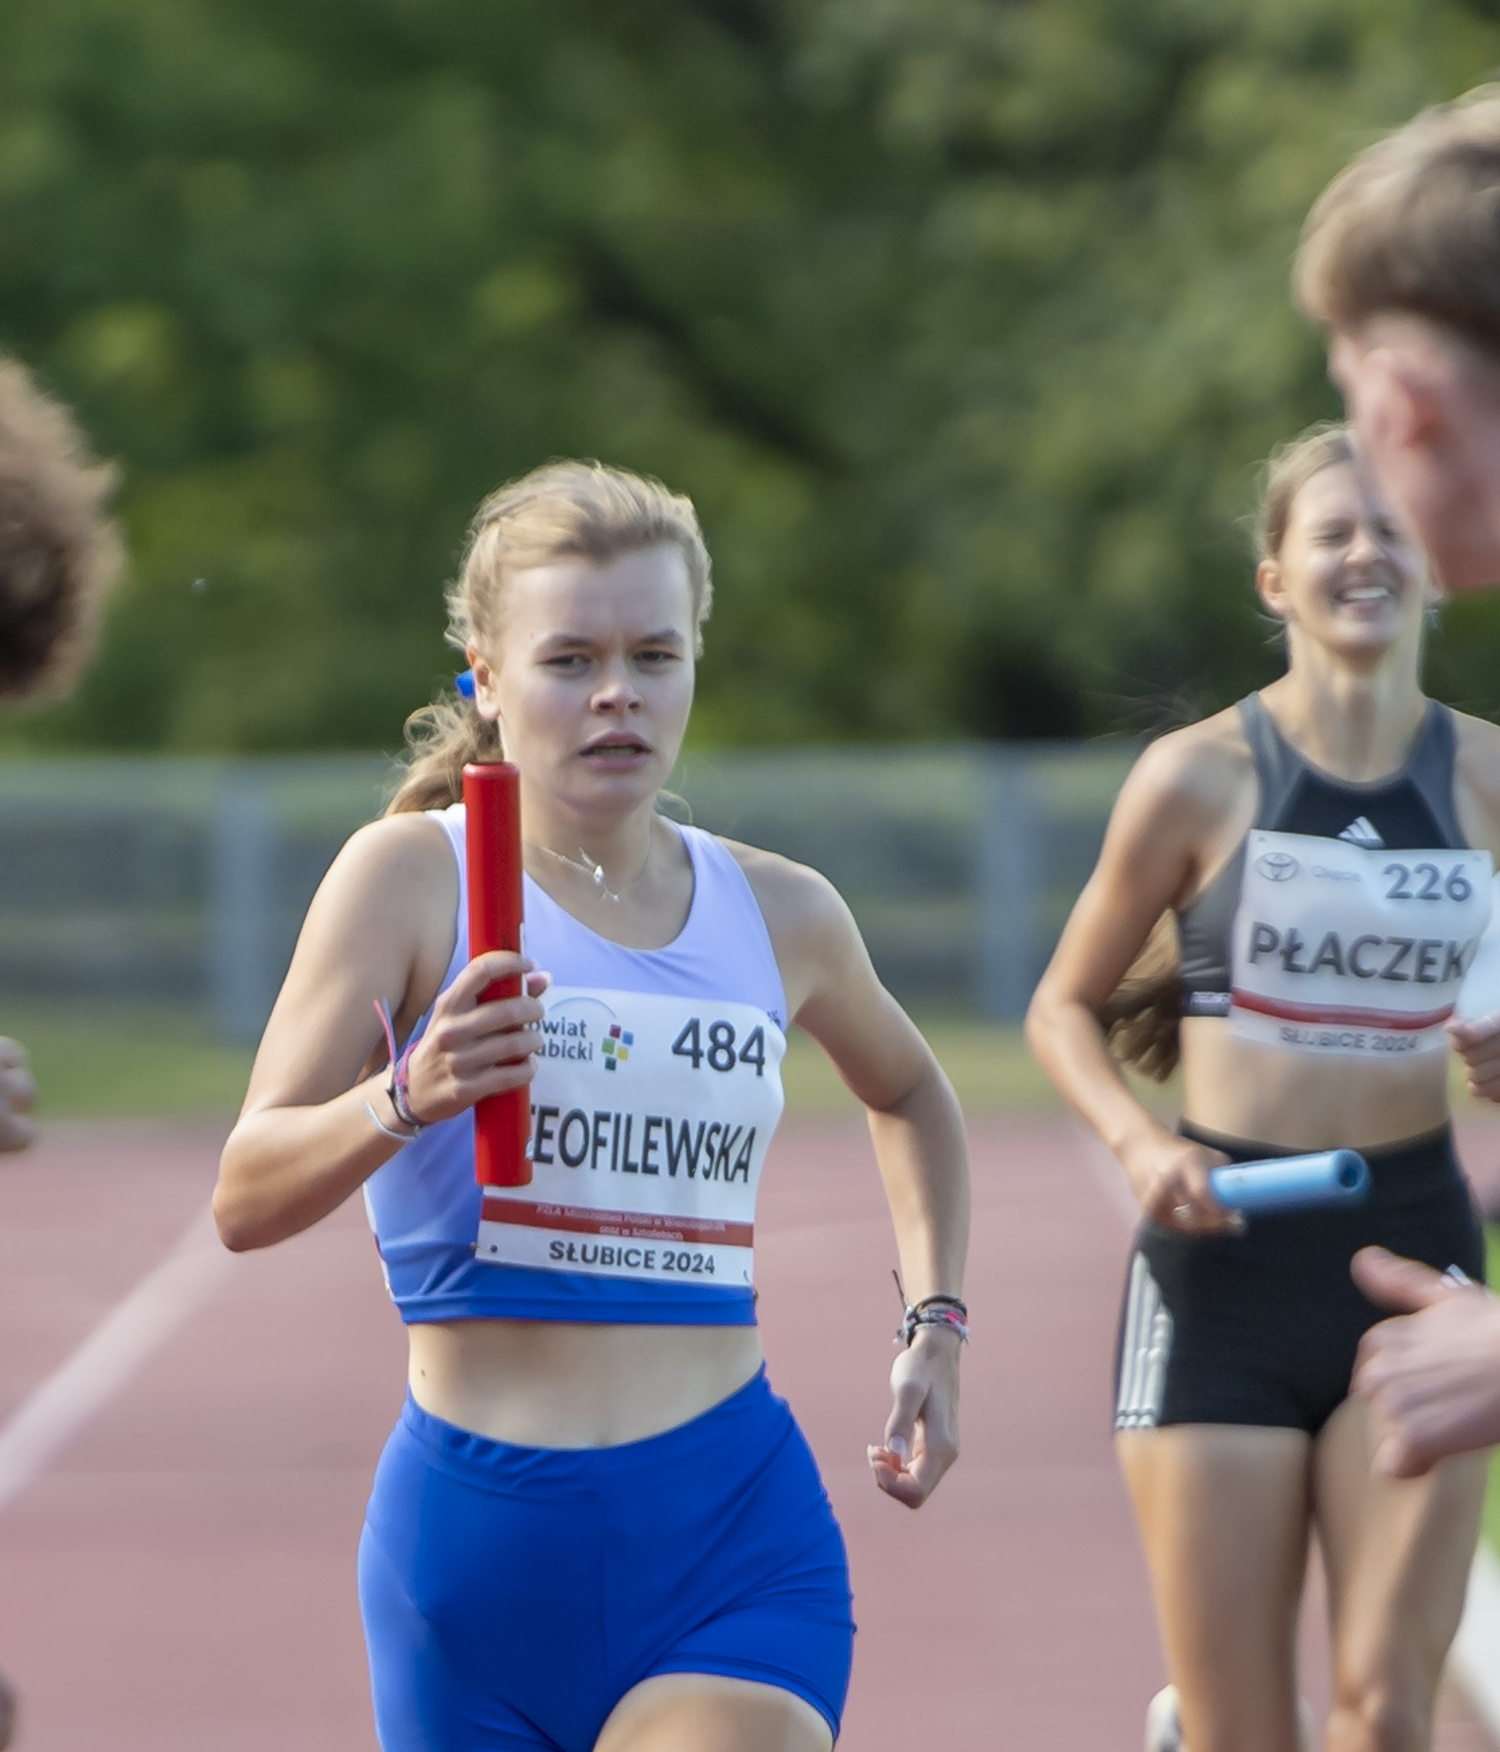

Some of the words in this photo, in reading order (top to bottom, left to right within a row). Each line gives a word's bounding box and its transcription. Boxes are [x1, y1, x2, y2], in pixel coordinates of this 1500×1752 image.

[1383, 863, 1472, 902] 226
[528, 1016, 587, 1038] owiat
[1371, 1035, 1418, 1052] 2024
[534, 1037, 593, 1061] ubicki
[671, 1017, 766, 1077] 484
[530, 1104, 758, 1184] EOFILEWSKA
[549, 1240, 656, 1271] SŁUBICE
[662, 1251, 716, 1275] 2024
